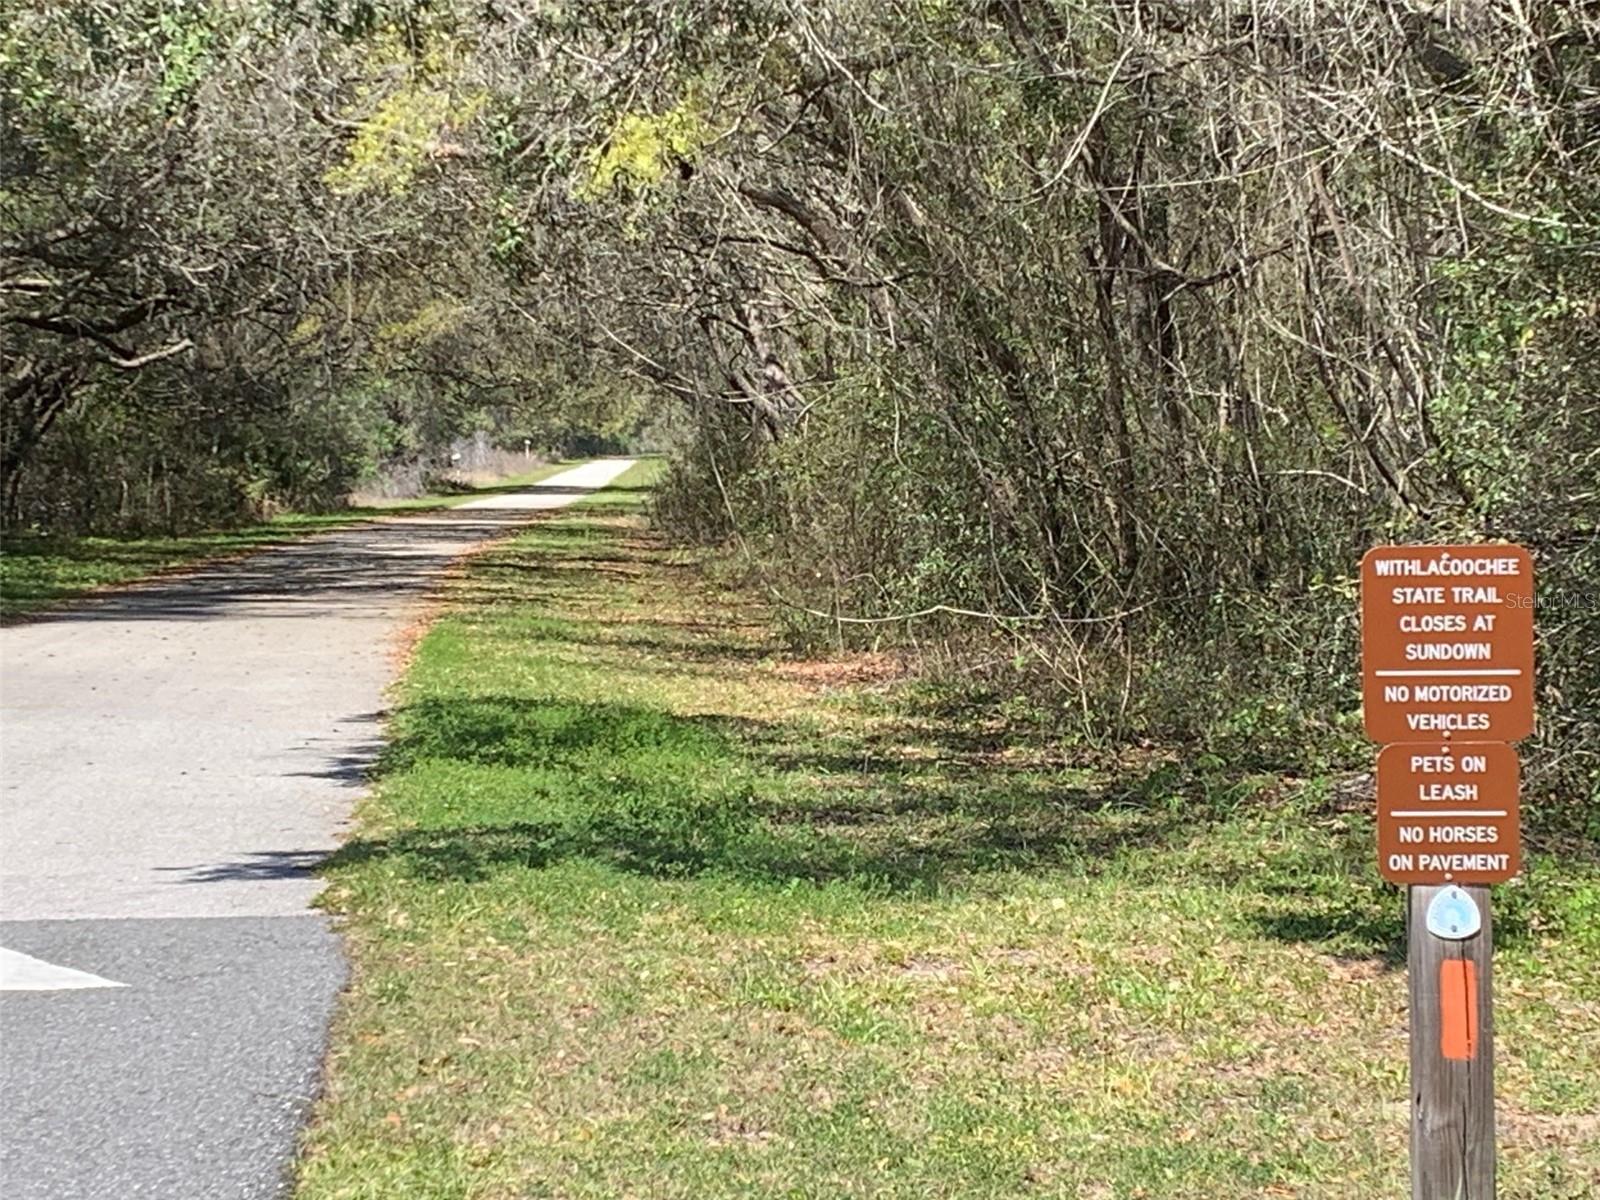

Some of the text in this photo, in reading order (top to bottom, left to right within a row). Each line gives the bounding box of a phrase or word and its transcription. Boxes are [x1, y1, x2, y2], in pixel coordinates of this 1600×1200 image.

[1375, 558, 1520, 576] WITHLACOOCHEE
[1392, 587, 1503, 604] STATE TRAIL
[1400, 615, 1496, 632] CLOSES AT
[1405, 643, 1491, 660] SUNDOWN
[1385, 685, 1512, 702] NO MOTORIZED
[1407, 714, 1490, 730] VEHICLES
[1411, 756, 1486, 773] PETS ON
[1419, 784, 1478, 801] LEASH
[1399, 826, 1498, 843] NO HORSES
[1389, 854, 1510, 871] ON PAVEMENT
